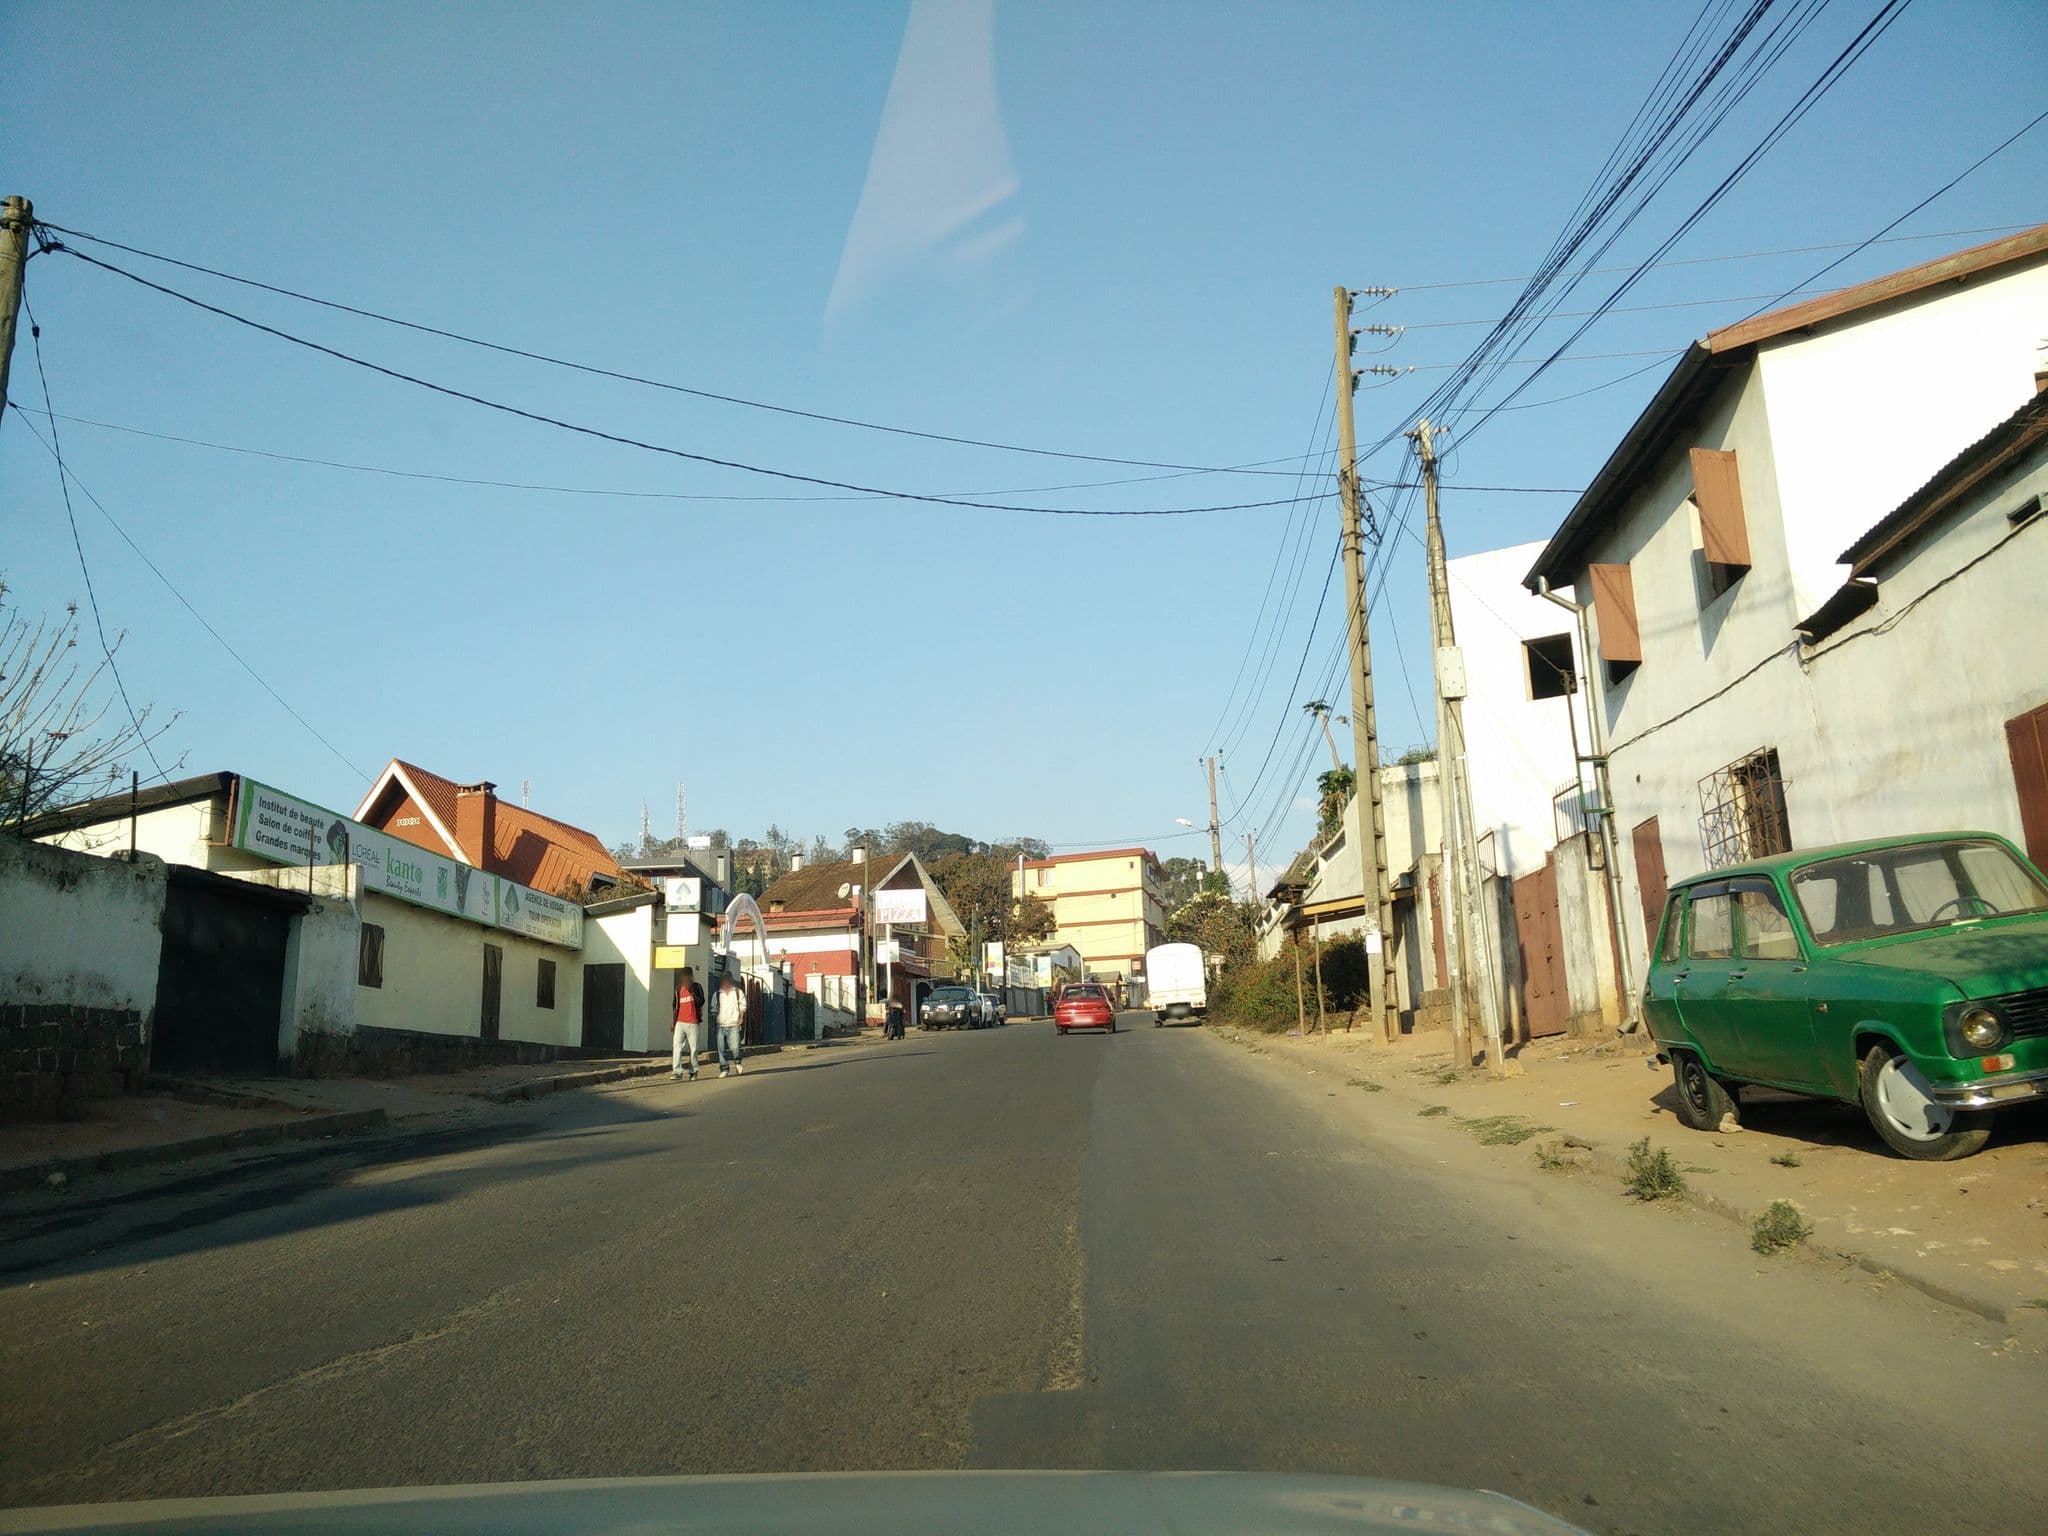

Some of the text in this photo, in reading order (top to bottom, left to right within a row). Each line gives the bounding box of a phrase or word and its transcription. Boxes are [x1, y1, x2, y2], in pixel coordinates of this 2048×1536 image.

[258, 796, 325, 830] Institut de beauté
[258, 813, 322, 844] Salon de coiffre
[255, 830, 289, 850] Grandes
[386, 847, 424, 884] kanto
[525, 891, 543, 906] AGENCE
[542, 897, 550, 909] DE
